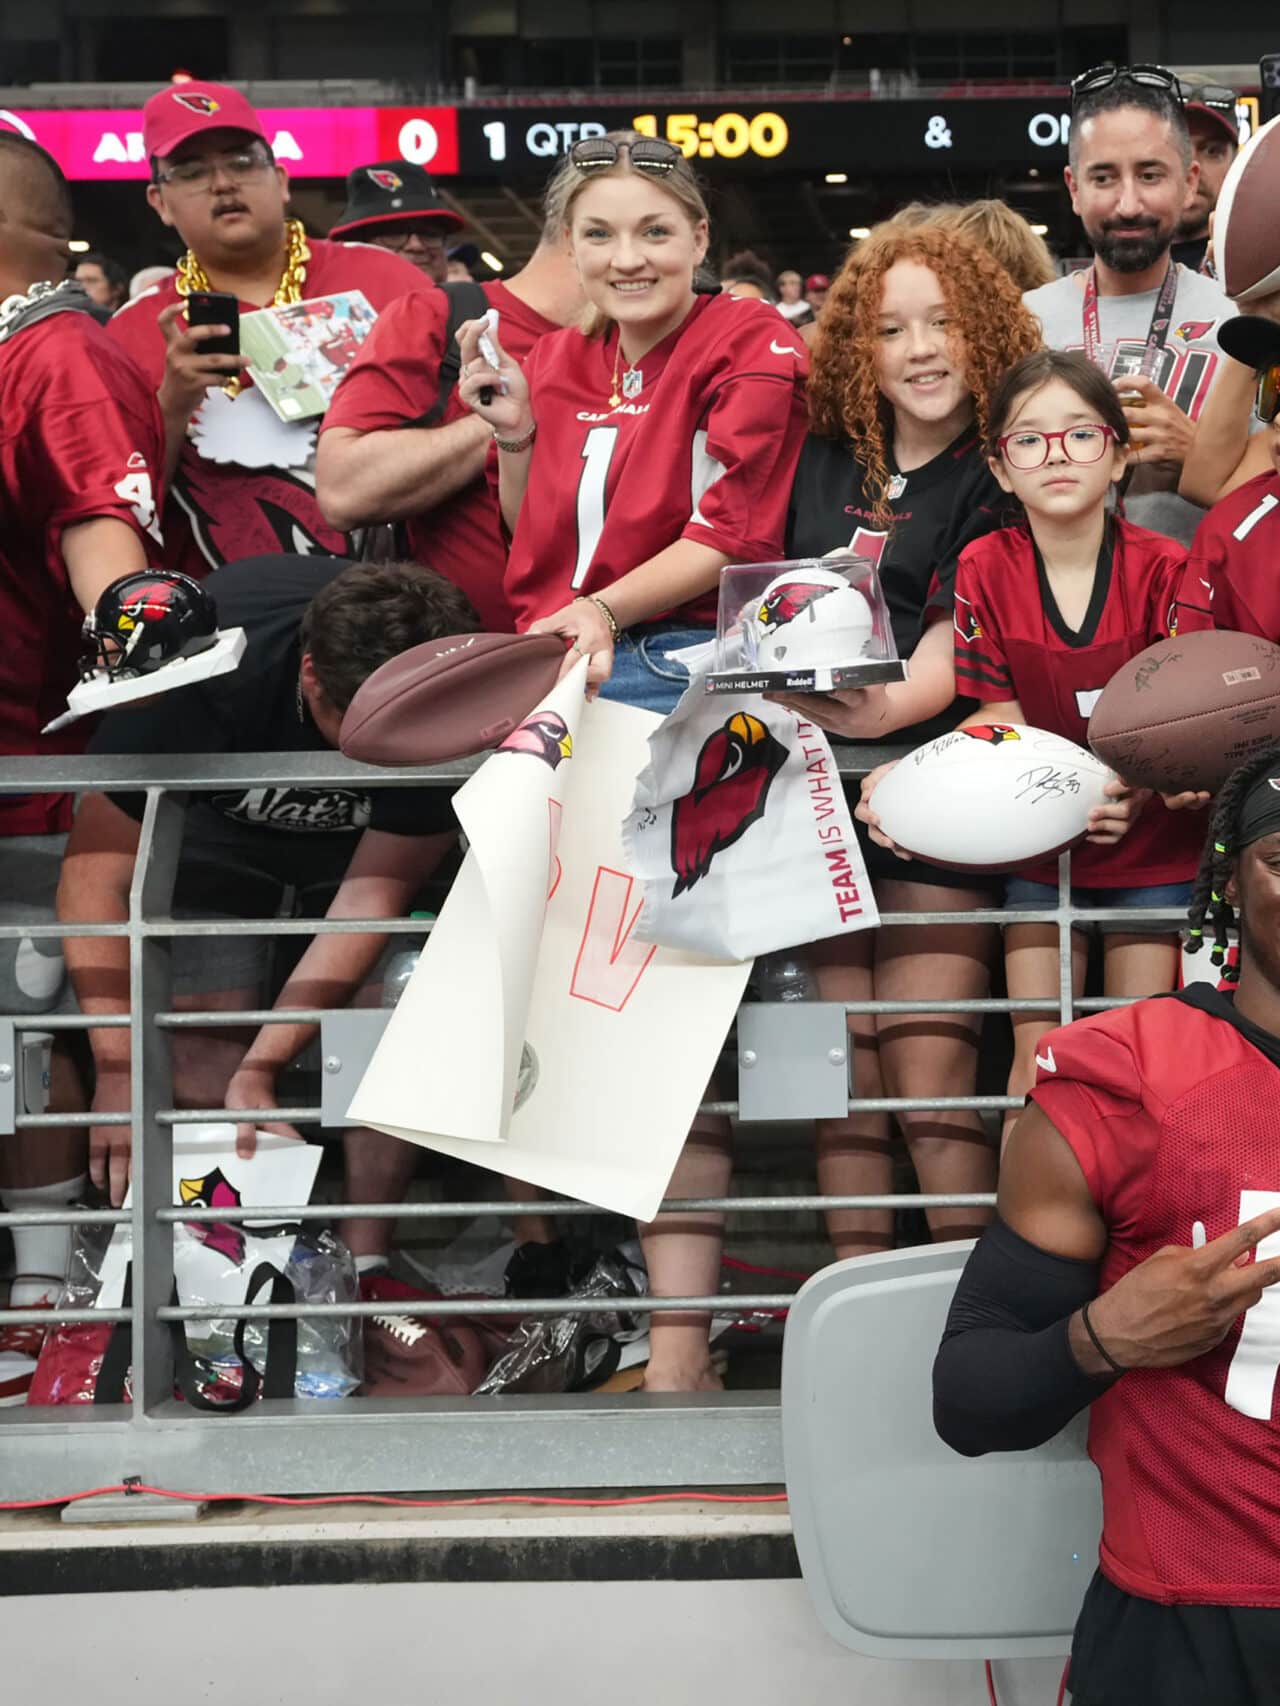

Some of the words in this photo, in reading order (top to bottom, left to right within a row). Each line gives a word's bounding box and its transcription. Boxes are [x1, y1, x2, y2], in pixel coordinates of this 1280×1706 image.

[398, 119, 438, 165] 0
[483, 121, 506, 160] 1
[924, 115, 952, 148] &
[803, 745, 835, 822] WHAT
[818, 825, 844, 846] IS
[825, 848, 863, 923] TEAM
